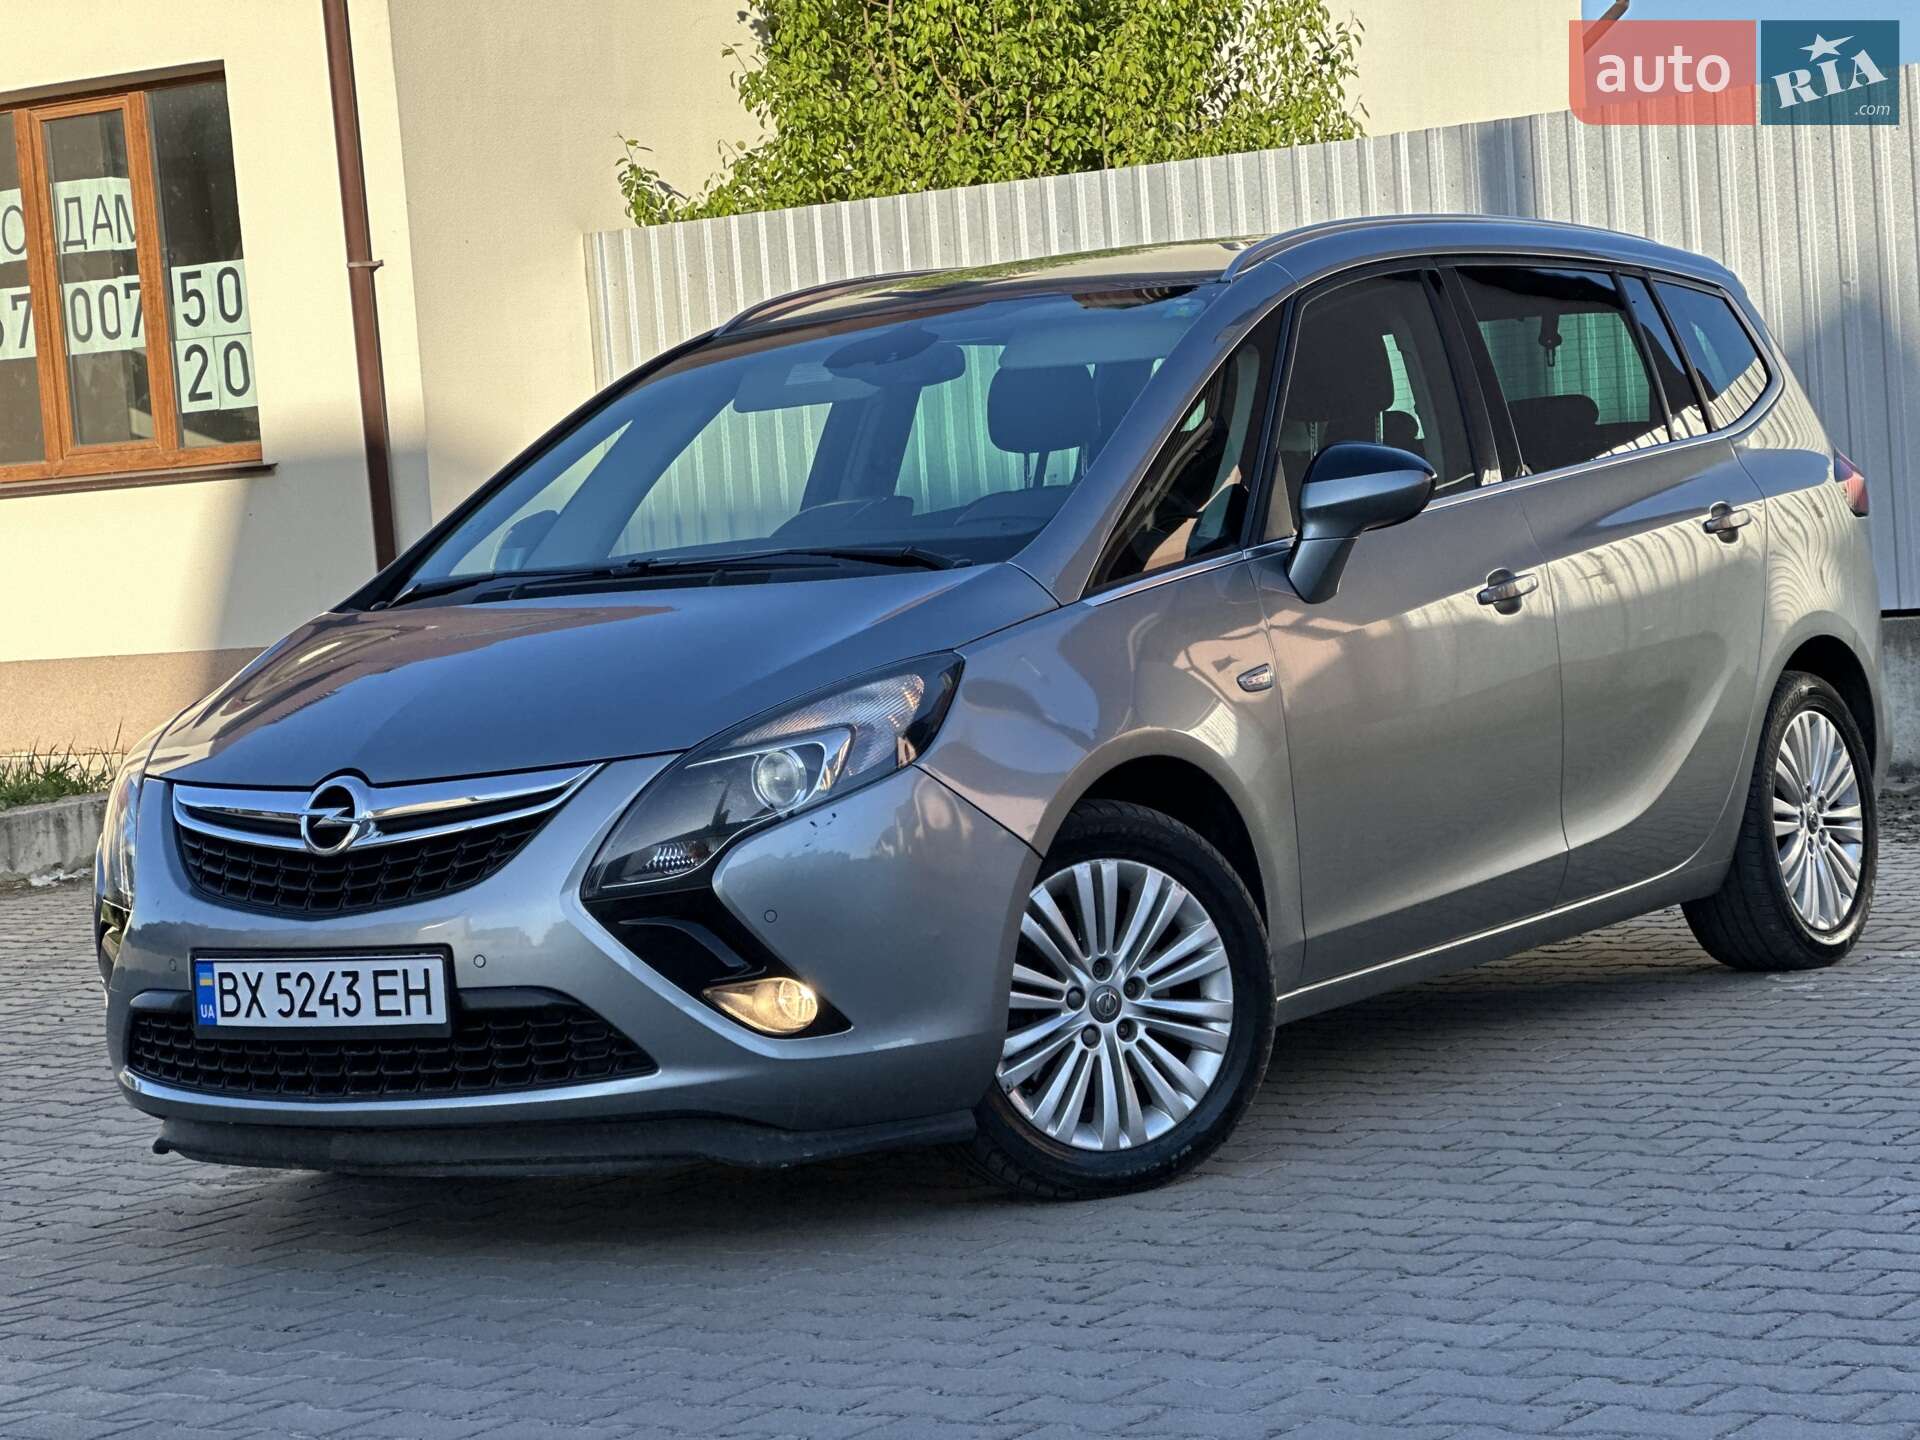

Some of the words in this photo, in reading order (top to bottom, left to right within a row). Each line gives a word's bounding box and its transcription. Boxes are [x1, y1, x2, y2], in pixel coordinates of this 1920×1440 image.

[69, 282, 144, 343] 007
[180, 266, 243, 328] 50
[184, 340, 251, 403] 20
[200, 1003, 216, 1019] UA
[275, 970, 362, 1018] 5243
[372, 967, 433, 1017] EH
